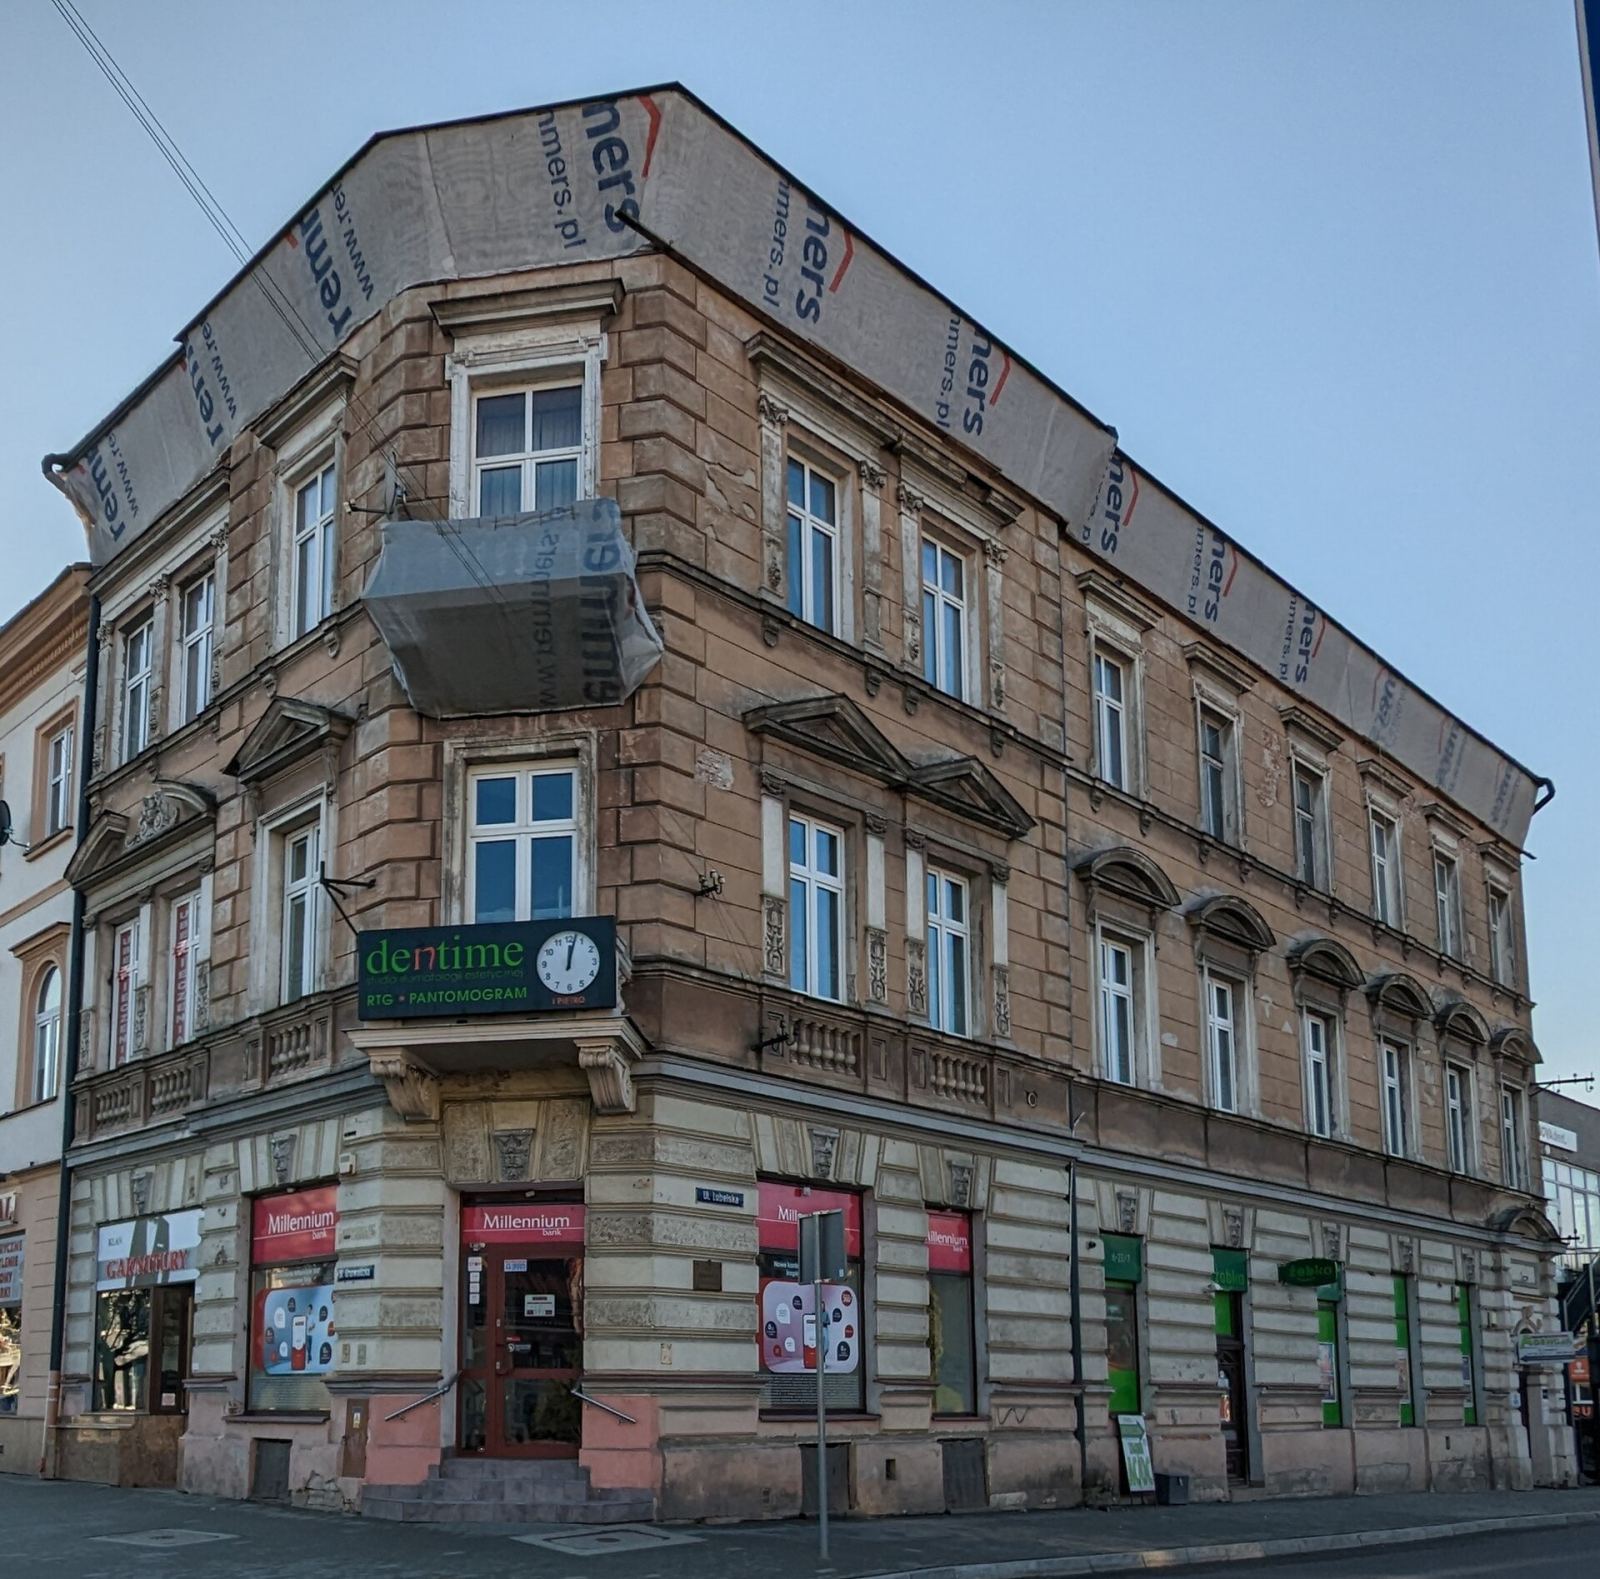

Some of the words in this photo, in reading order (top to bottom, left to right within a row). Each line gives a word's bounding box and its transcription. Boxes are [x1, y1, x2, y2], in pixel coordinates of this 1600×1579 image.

[555, 939, 562, 947] 11
[565, 935, 574, 944] 12
[545, 948, 554, 956] 10
[588, 945, 594, 954] 2
[366, 934, 524, 975] dentime
[541, 960, 548, 969] 9
[591, 958, 598, 966] 3
[545, 972, 551, 981] 8
[588, 969, 595, 977] 4
[554, 981, 560, 989] 7
[566, 983, 573, 992] 6
[578, 980, 585, 988] 5
[367, 993, 393, 1007] RTG
[409, 987, 528, 1004] PANTOMOGRAM
[267, 1210, 334, 1235] Millennium
[483, 1212, 570, 1229] Millennium
[312, 1230, 328, 1240] bank
[543, 1228, 562, 1236] bank
[106, 1249, 189, 1280] GARNITURY
